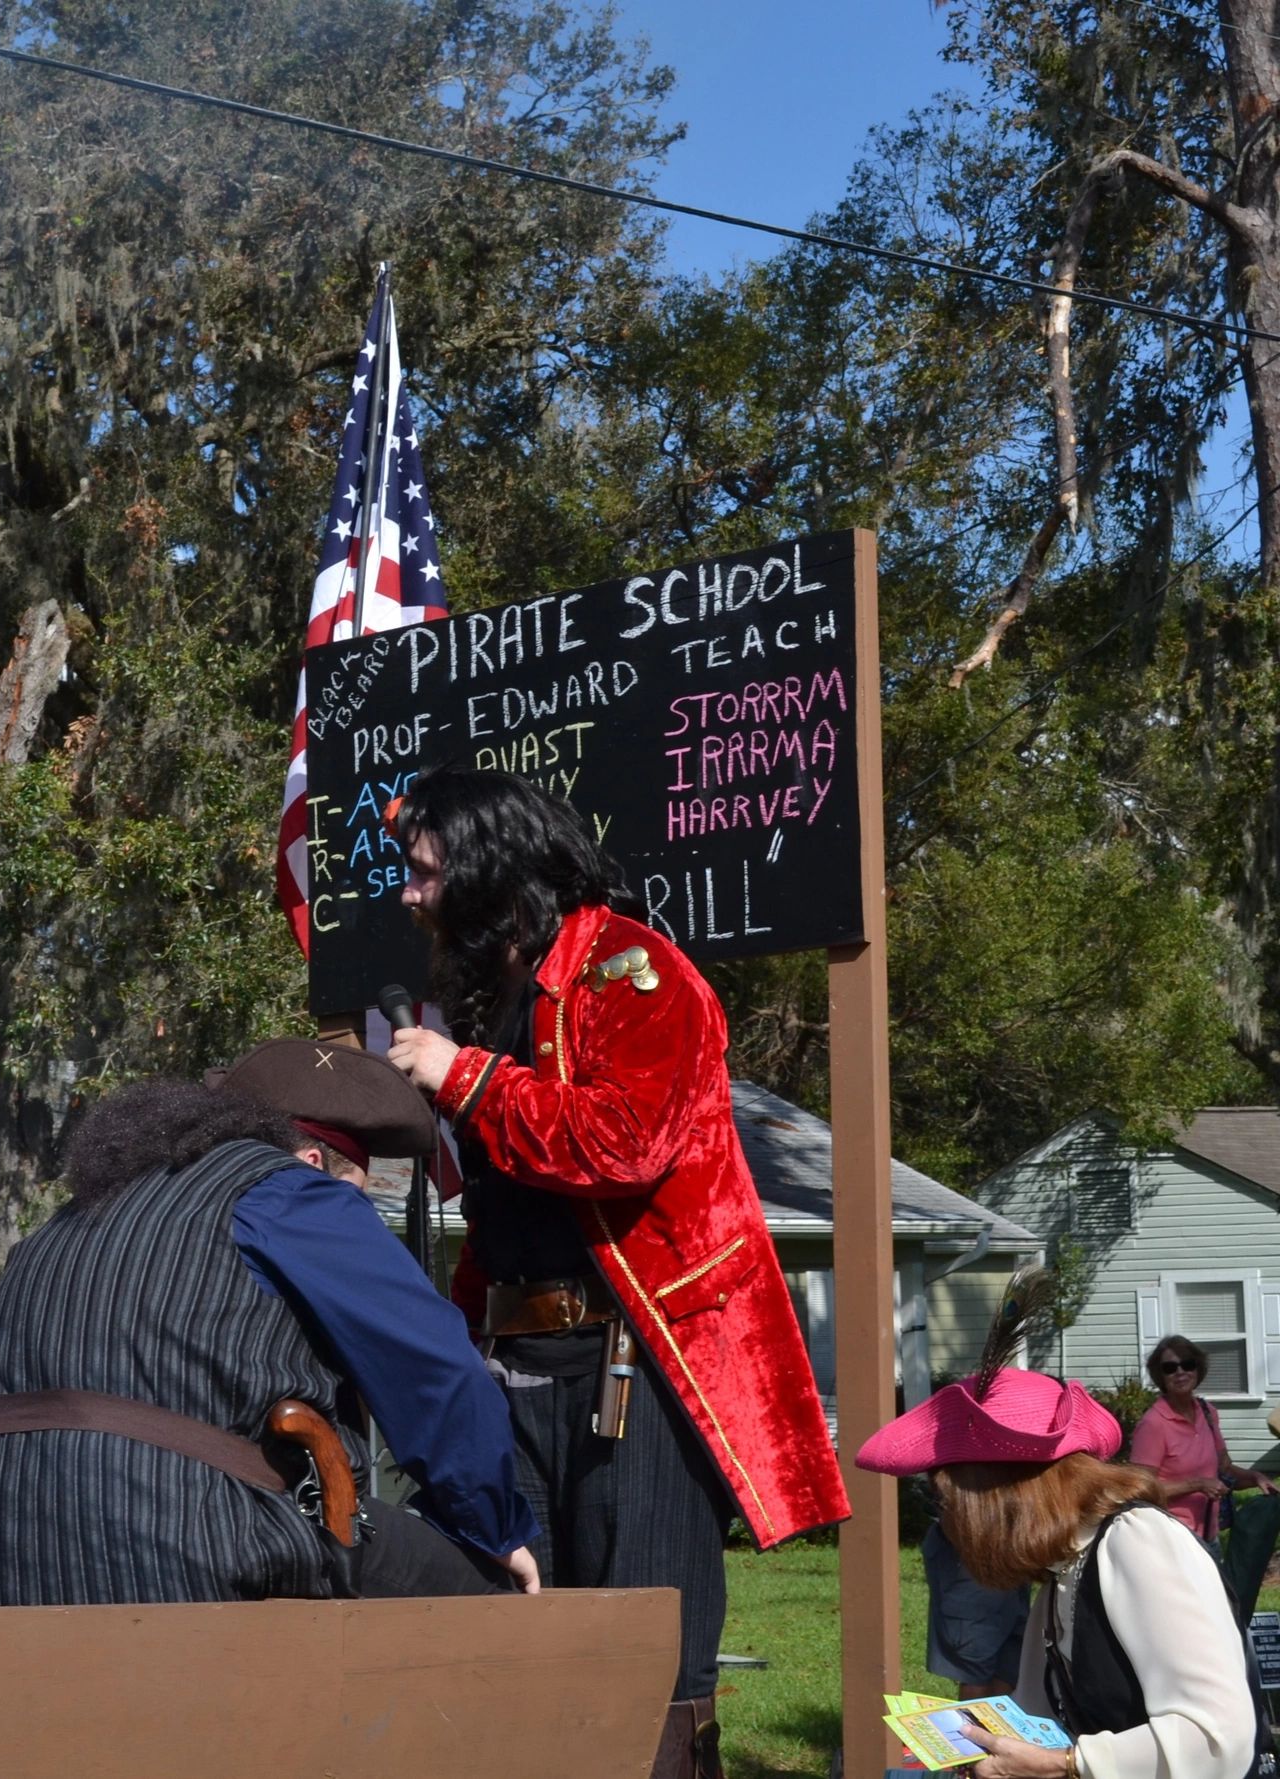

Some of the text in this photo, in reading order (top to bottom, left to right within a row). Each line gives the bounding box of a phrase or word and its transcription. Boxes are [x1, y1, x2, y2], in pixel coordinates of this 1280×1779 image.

[396, 543, 827, 695] PIRATE SCHOOL
[307, 651, 362, 741] BLACK
[335, 636, 390, 729] BEARD
[467, 660, 639, 739] EDWARD
[670, 609, 837, 674] TEACH
[664, 666, 847, 737] STORRRM
[667, 777, 832, 842] HARRVEY
